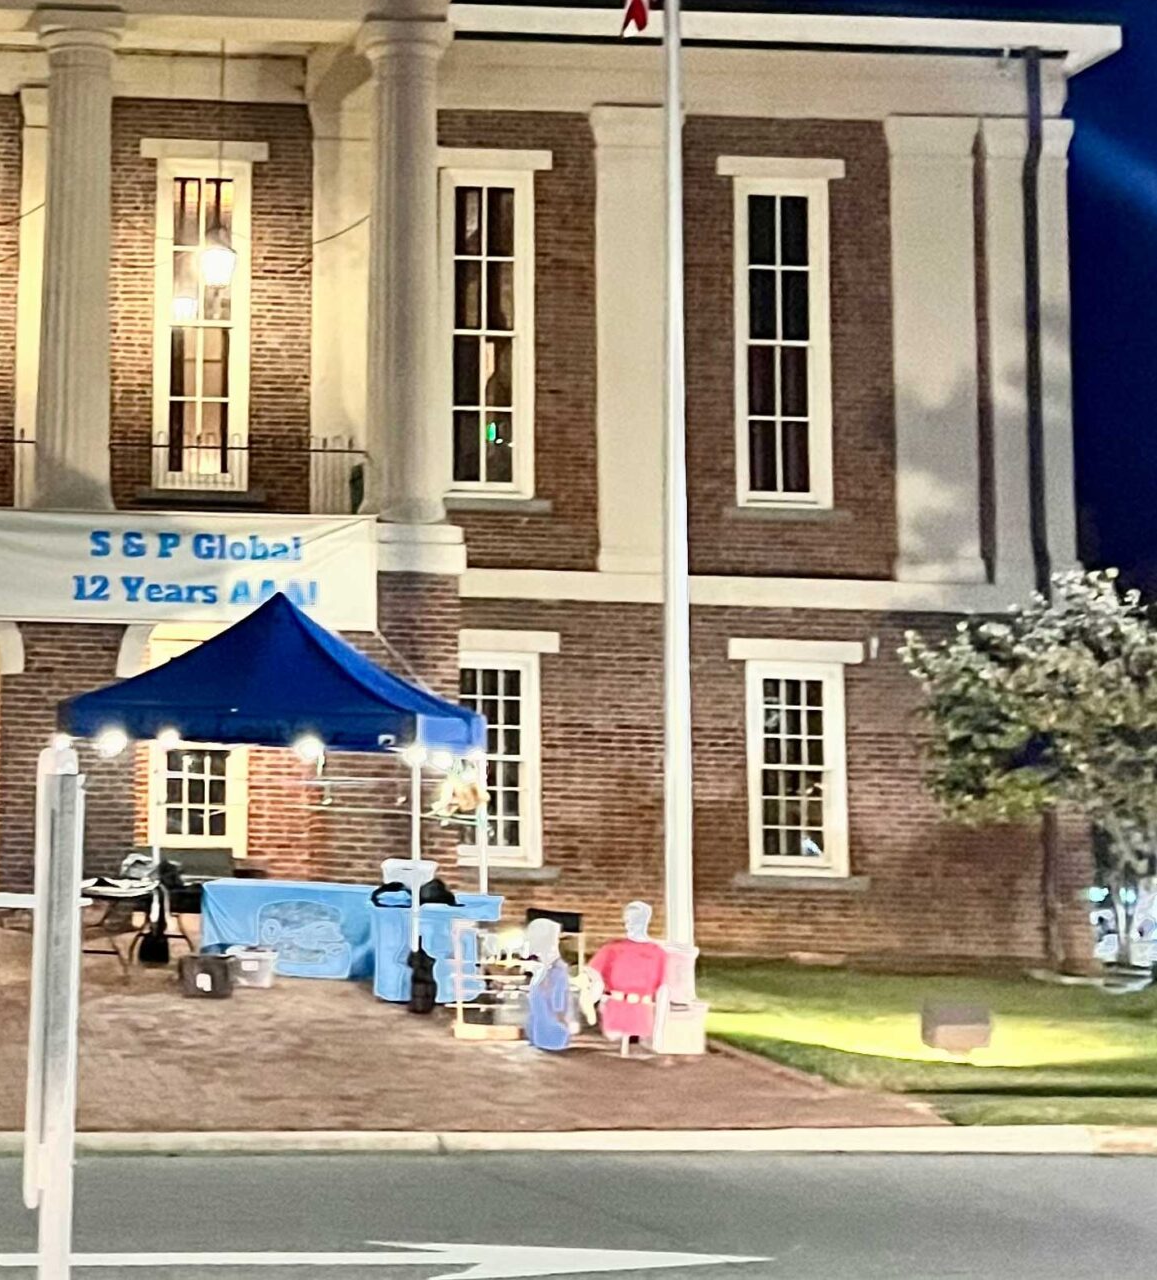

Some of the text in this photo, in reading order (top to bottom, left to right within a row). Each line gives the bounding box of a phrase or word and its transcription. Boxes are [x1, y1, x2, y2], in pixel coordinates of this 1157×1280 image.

[89, 530, 302, 560] S & P Global
[72, 575, 110, 601] 12
[120, 576, 218, 604] Years
